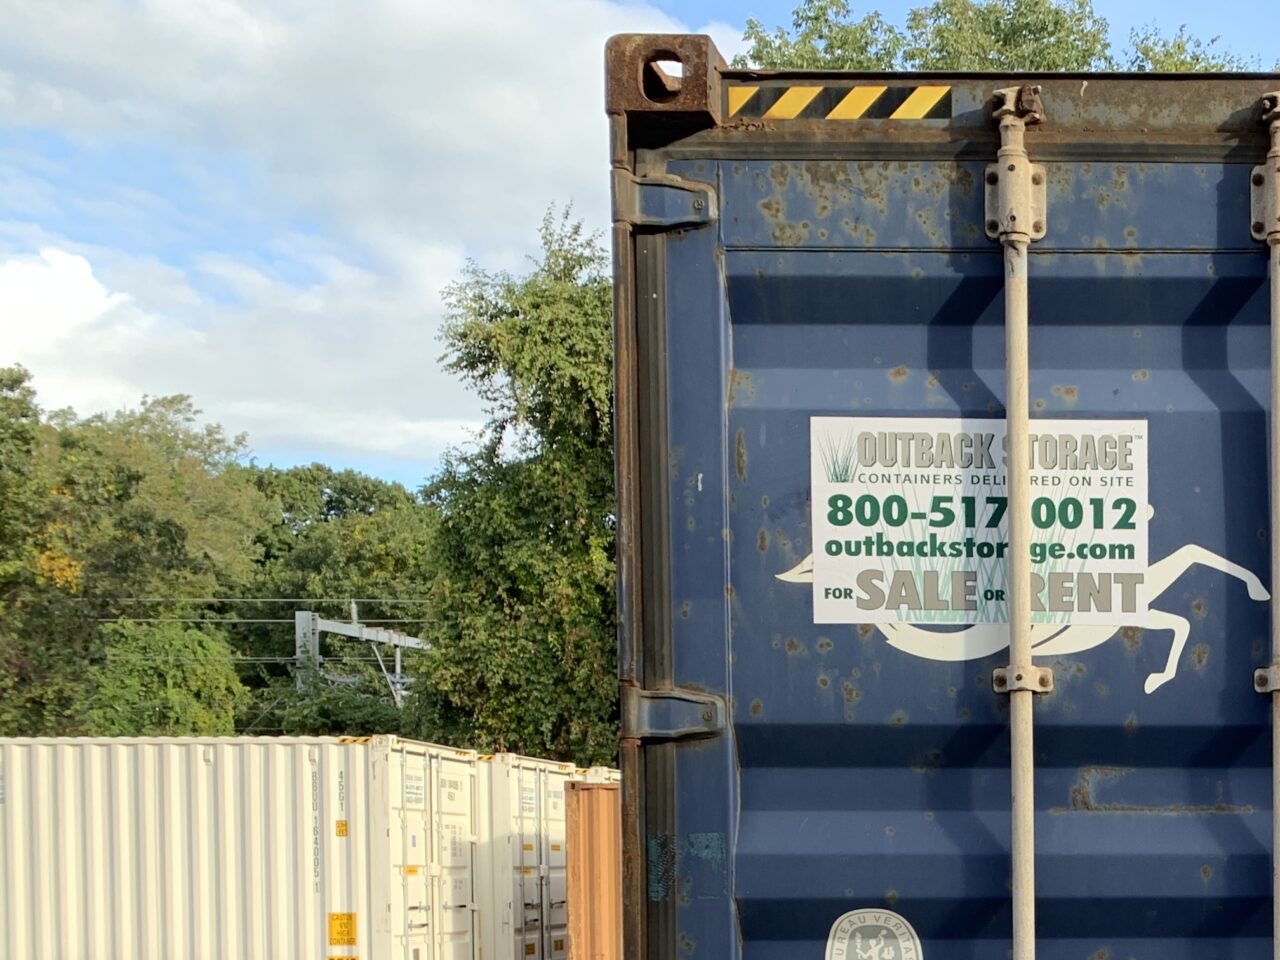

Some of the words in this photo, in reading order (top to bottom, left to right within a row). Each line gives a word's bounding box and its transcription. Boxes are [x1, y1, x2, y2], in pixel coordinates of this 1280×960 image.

[857, 432, 996, 469] OUTBACK
[858, 473, 963, 485] CONTAINERS
[971, 474, 1061, 487] DELIRED
[1069, 475, 1092, 487] ON
[1100, 476, 1134, 487] SITE
[827, 494, 1136, 530] 800-5170012
[824, 532, 1135, 564] outbackstorge.com
[824, 587, 853, 599] FOR
[856, 569, 978, 612] SALE
[984, 589, 1006, 602] OR
